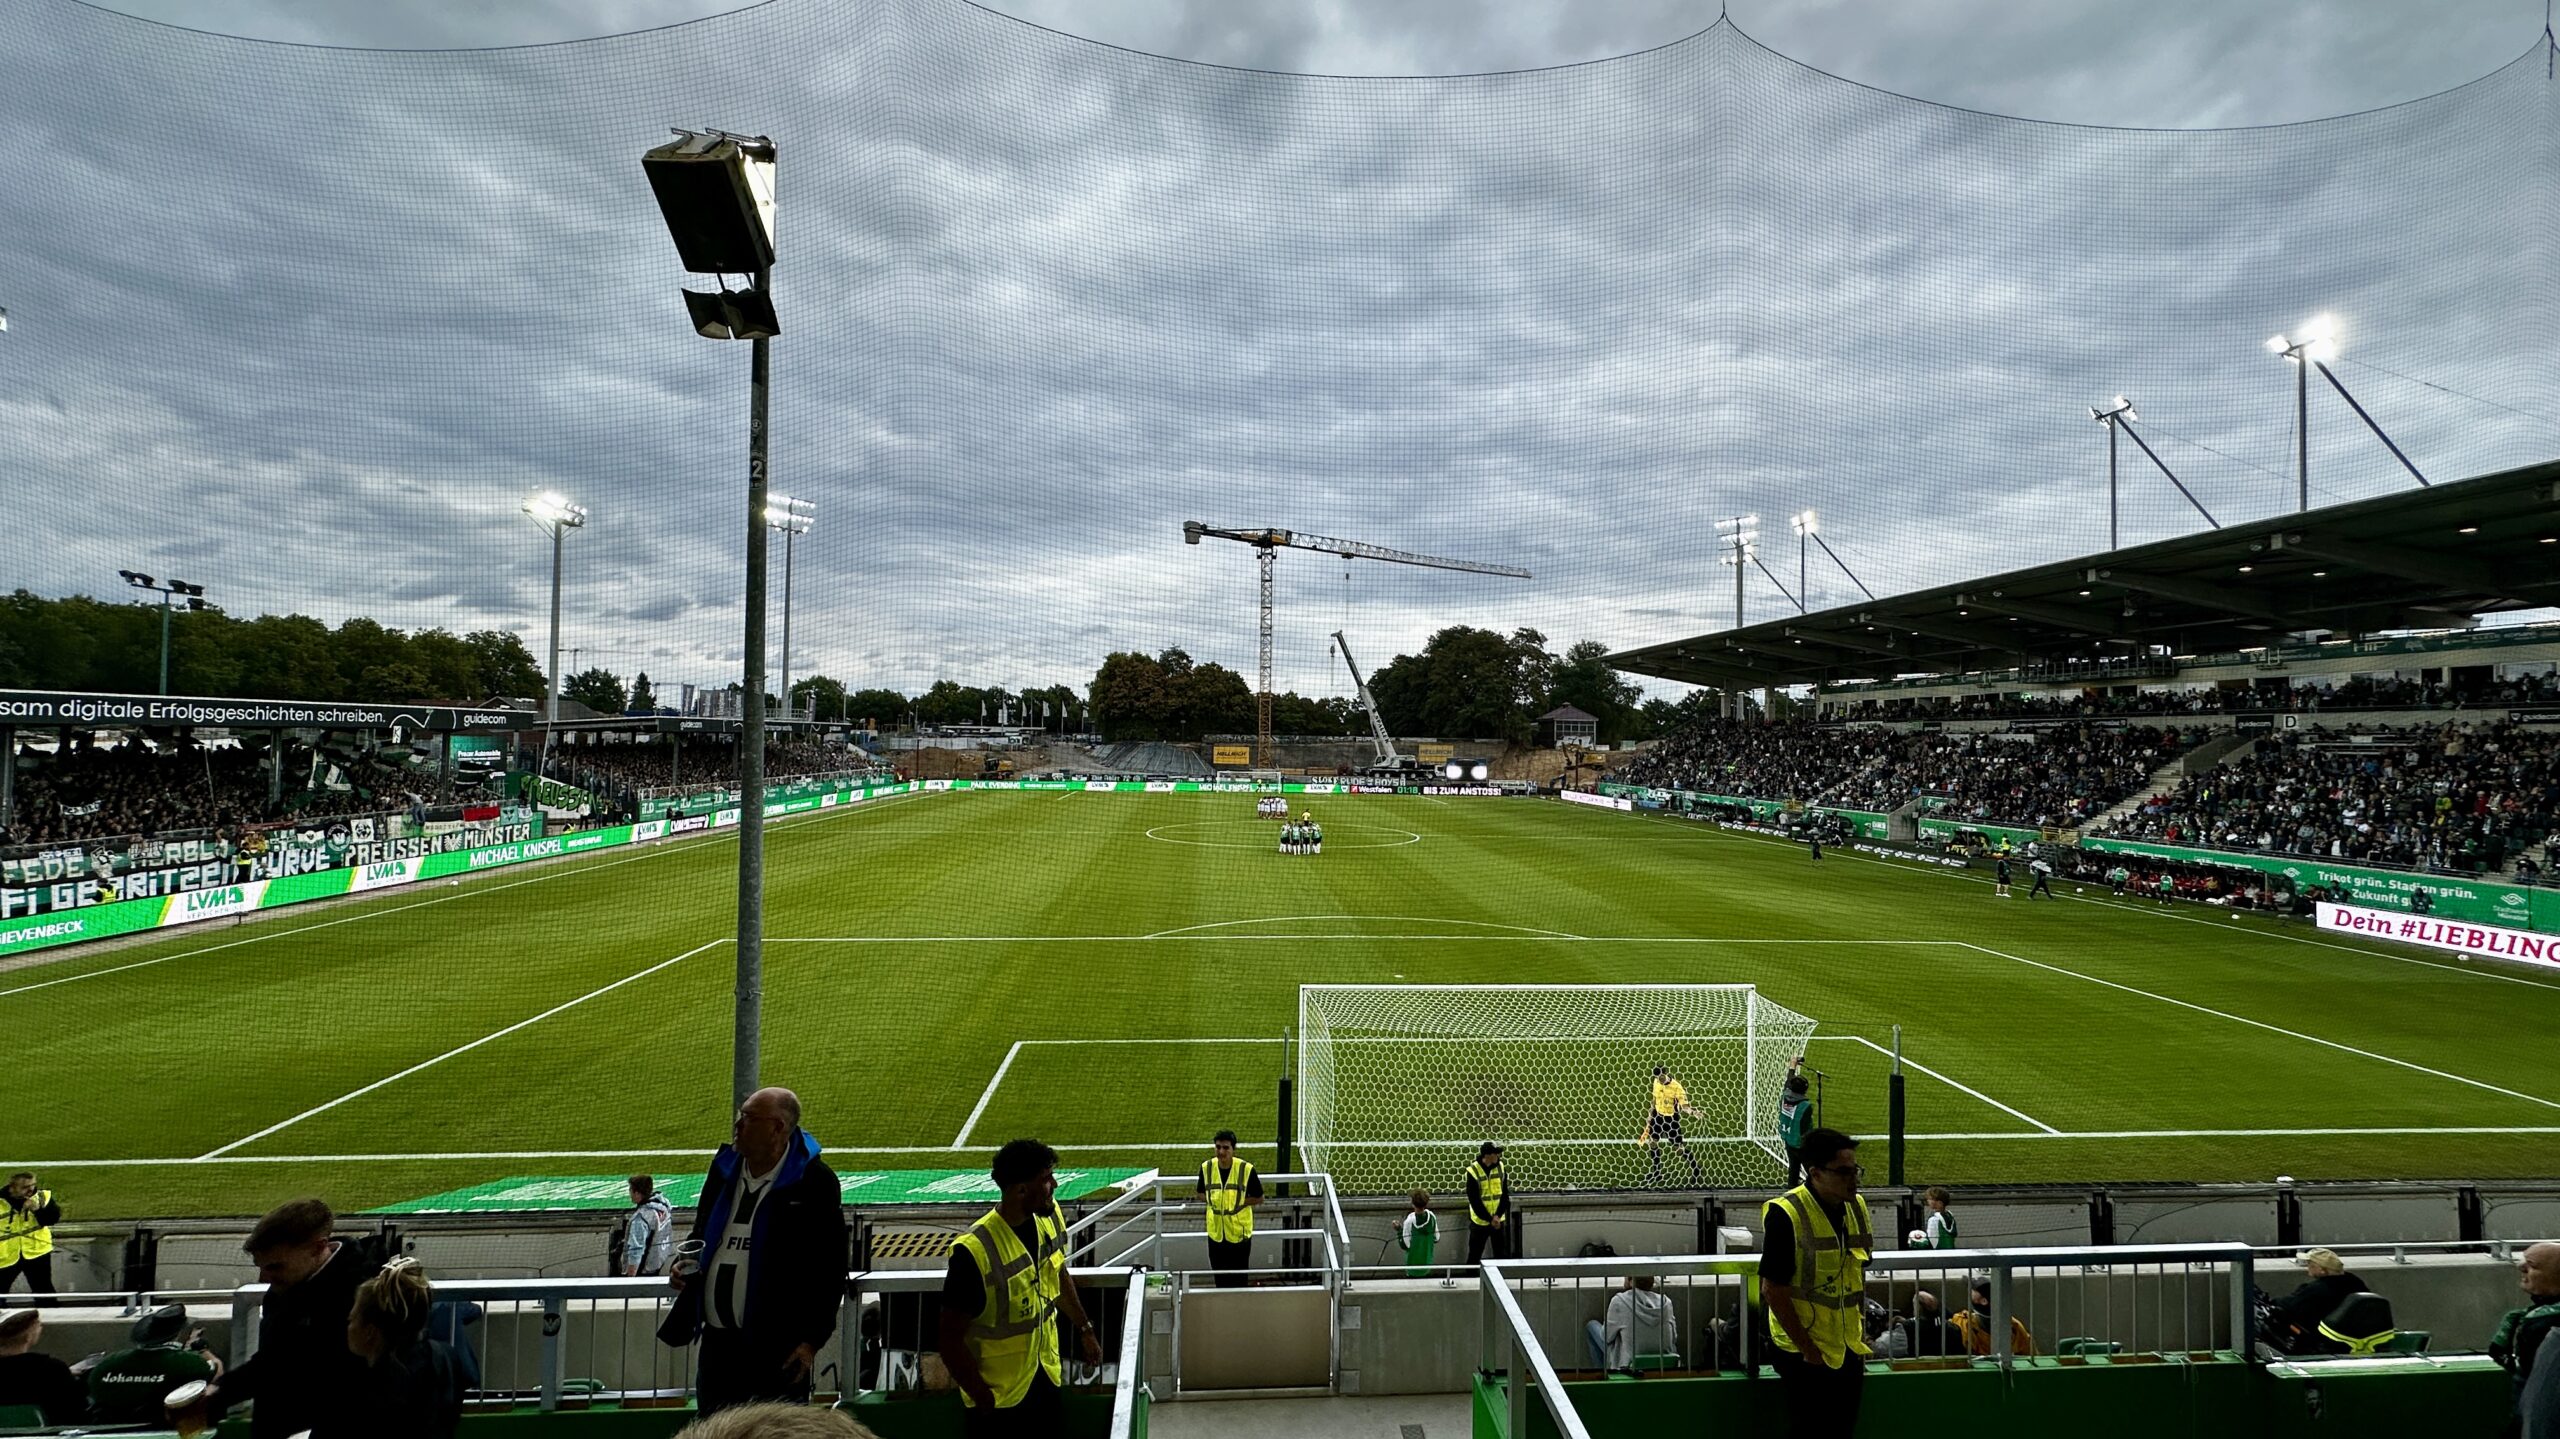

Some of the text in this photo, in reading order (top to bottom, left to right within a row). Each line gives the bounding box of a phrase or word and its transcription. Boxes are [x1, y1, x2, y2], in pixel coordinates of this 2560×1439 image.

[752, 460, 764, 479] 2
[59, 700, 145, 721] digitale
[149, 703, 314, 722] Erfolgsgeschichten
[316, 708, 386, 723] schreiben.
[463, 714, 507, 726] guidecom
[2285, 716, 2297, 729] D
[1423, 786, 1502, 796] BIS ZUM ANSTOSS!
[464, 823, 531, 850] MÜNSTER
[344, 834, 443, 867] PREUSSEN
[469, 845, 520, 868] MICHAEL
[522, 839, 563, 859] KNISPEL
[366, 862, 395, 882] LVM
[2317, 870, 2352, 884] Trikot
[2354, 874, 2386, 889] grün.
[2439, 885, 2478, 900] grün.
[2351, 889, 2399, 905] Zukunft
[2334, 909, 2393, 935] Dein
[102, 1371, 165, 1385] Johannes
